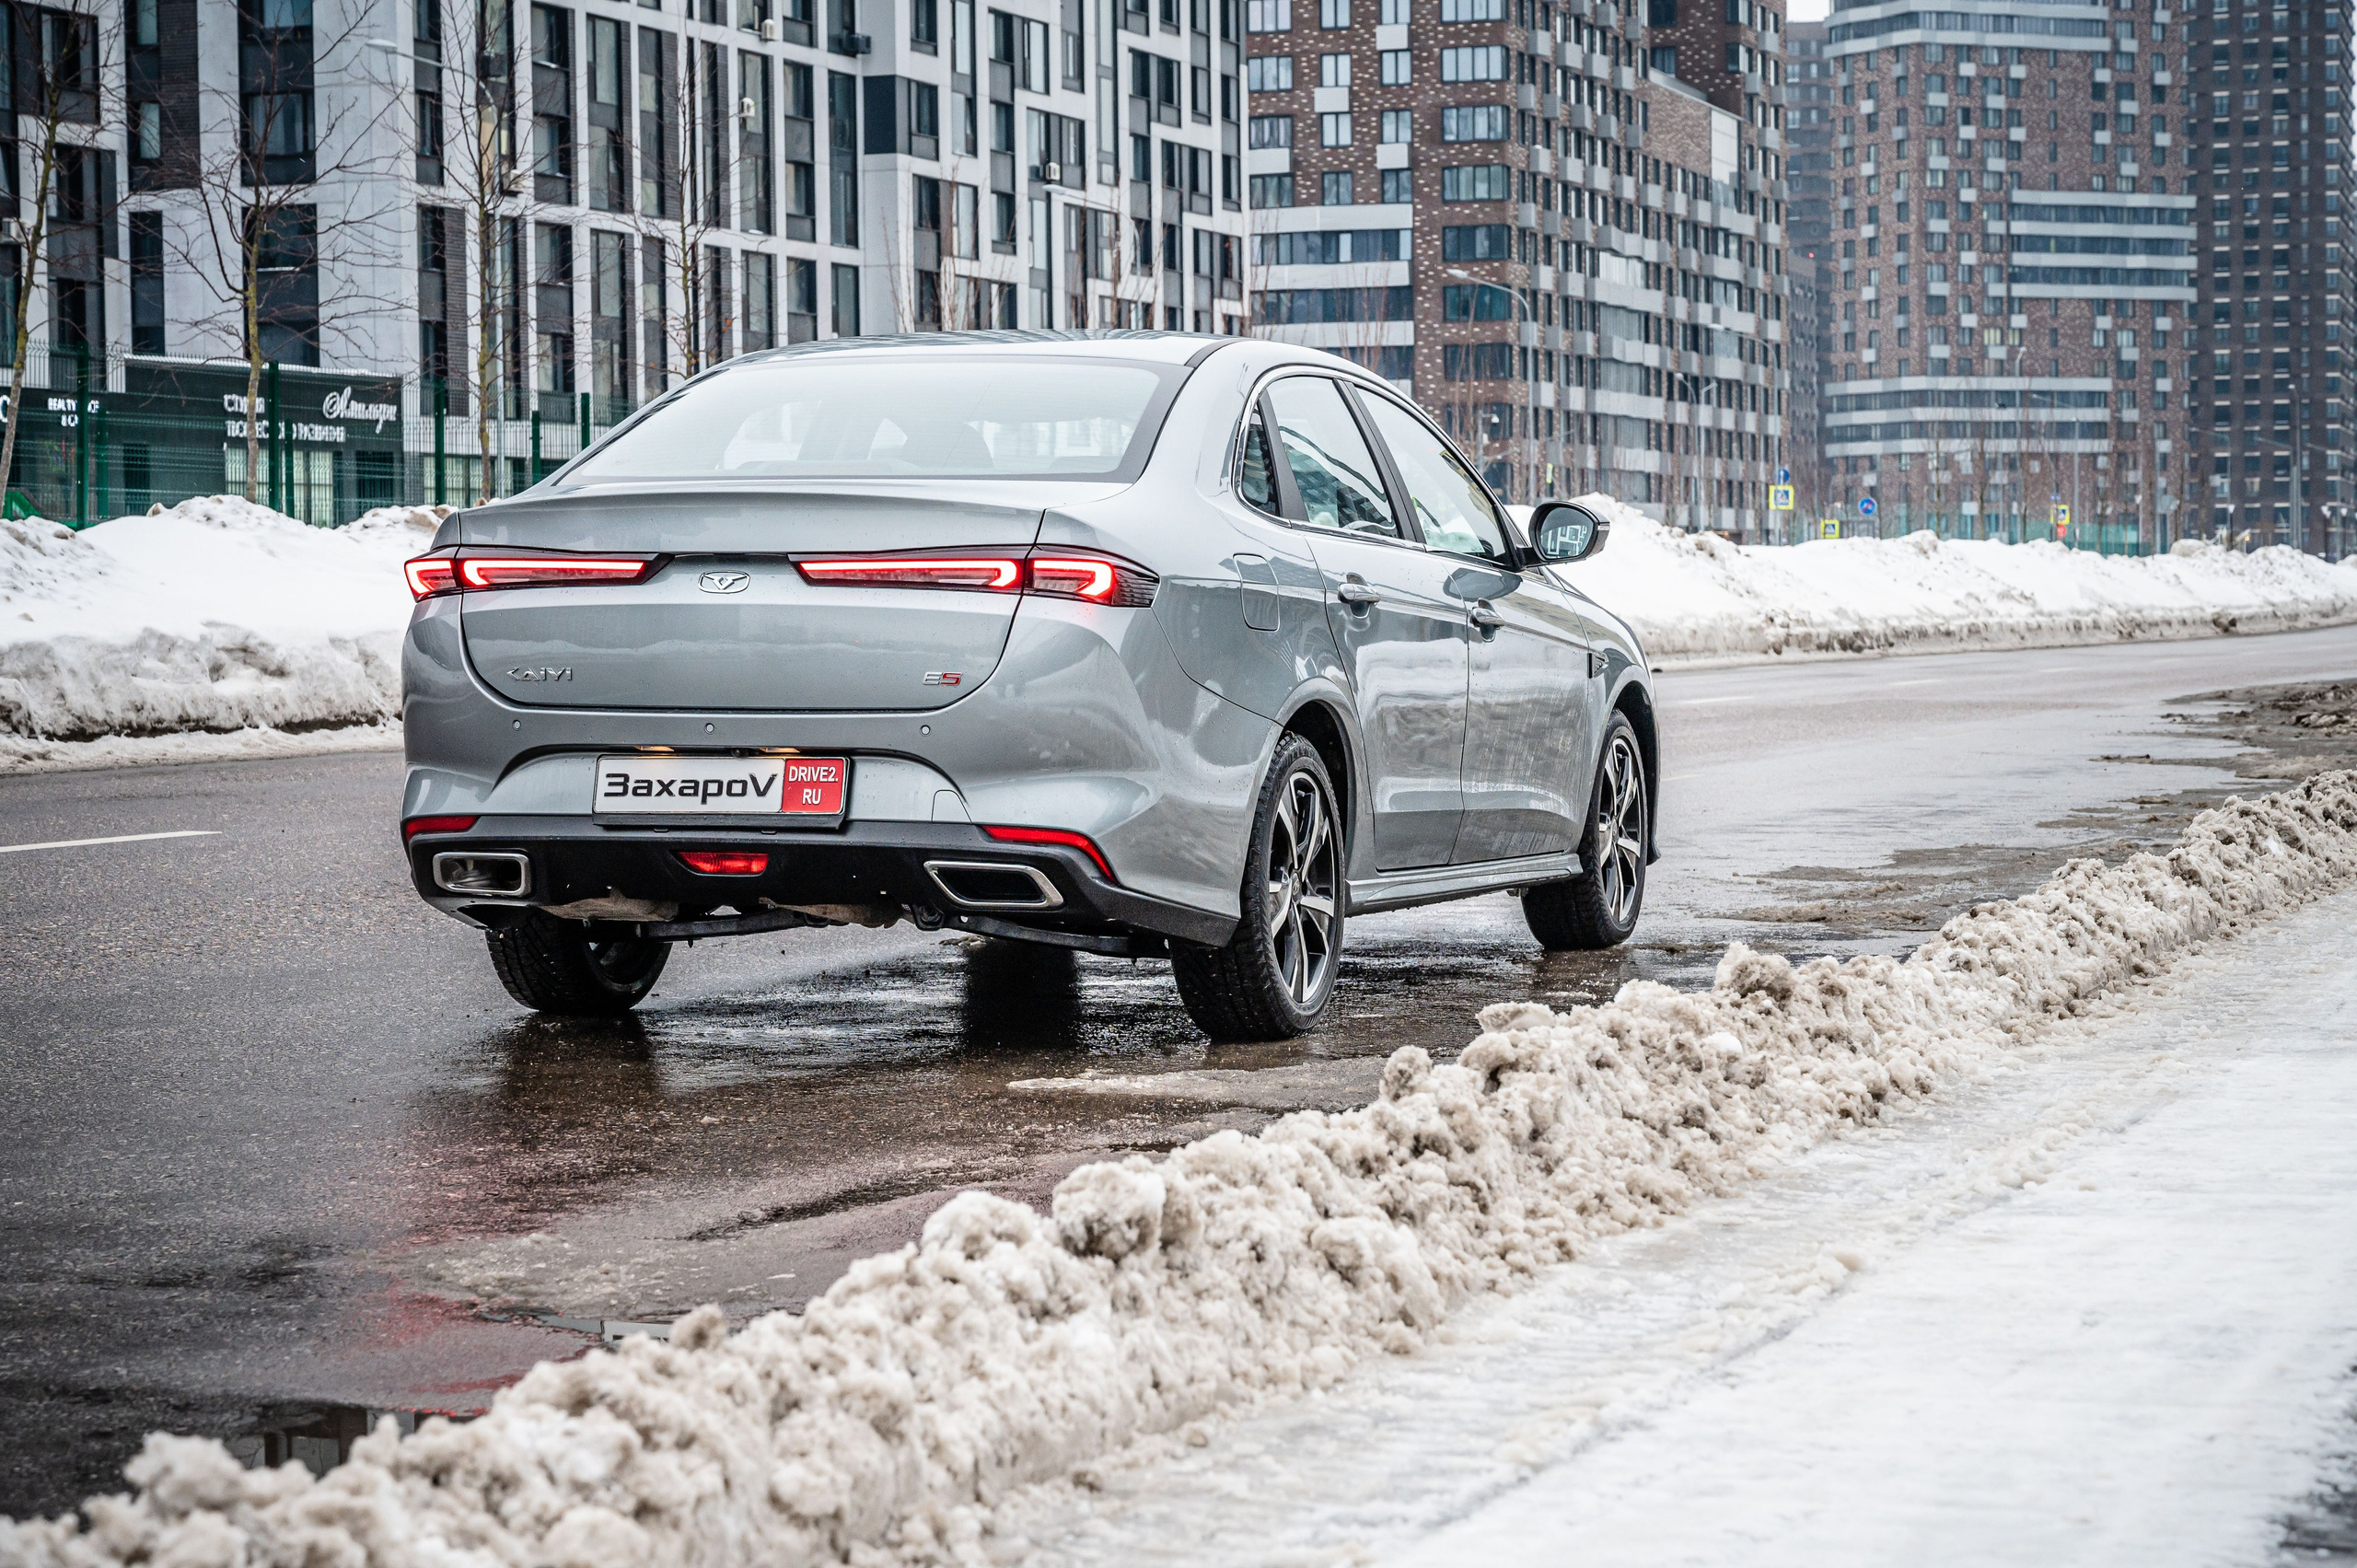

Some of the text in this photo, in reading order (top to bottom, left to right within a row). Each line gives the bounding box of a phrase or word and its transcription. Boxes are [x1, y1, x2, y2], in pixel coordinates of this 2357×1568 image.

[506, 667, 572, 681] KAIYI
[788, 765, 839, 783] DRIVE2.
[802, 788, 822, 805] RU
